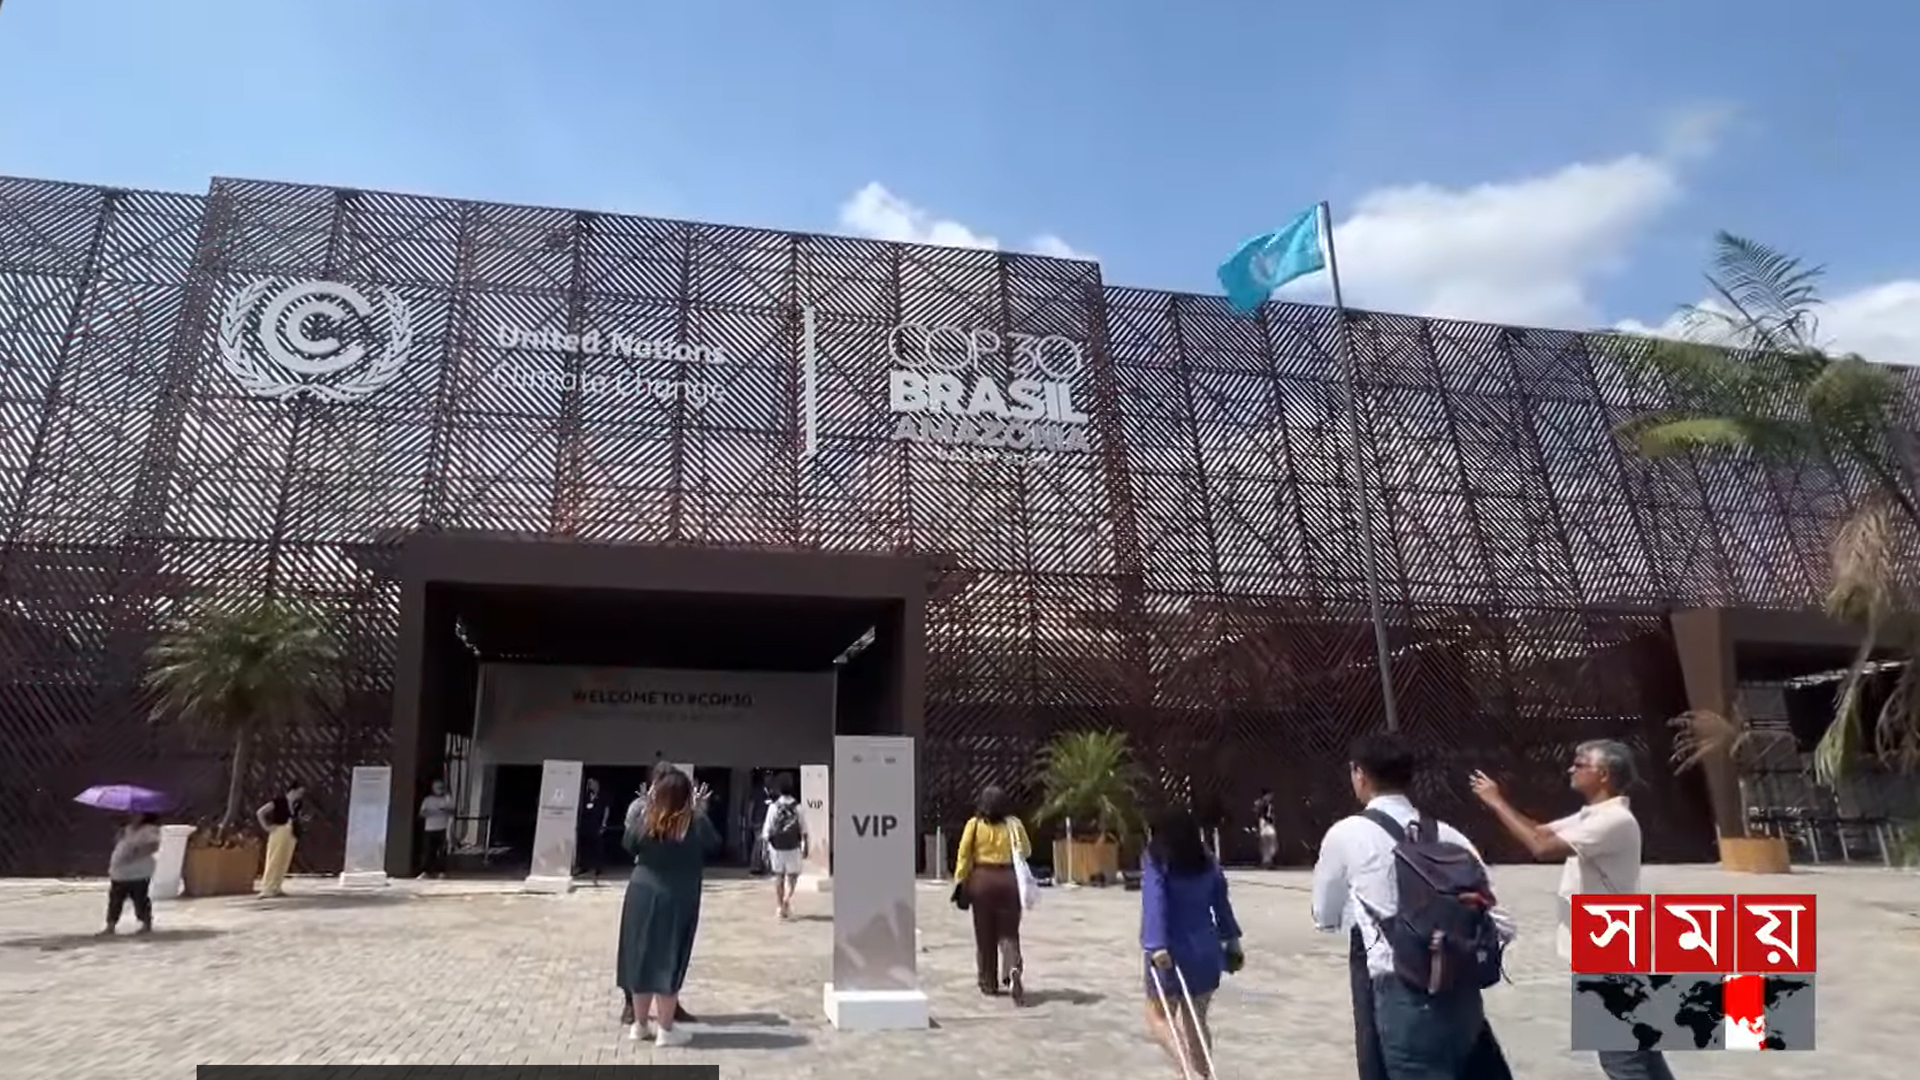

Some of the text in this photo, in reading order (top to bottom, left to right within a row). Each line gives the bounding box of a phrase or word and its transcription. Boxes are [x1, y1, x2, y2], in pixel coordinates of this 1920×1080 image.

[498, 325, 726, 364] United Nations
[495, 360, 726, 409] Climate Change
[889, 370, 1090, 424] BRASIL
[571, 690, 658, 706] WELCOME
[662, 691, 684, 706] TO
[806, 797, 823, 809] VIP
[851, 814, 898, 838] VIP
